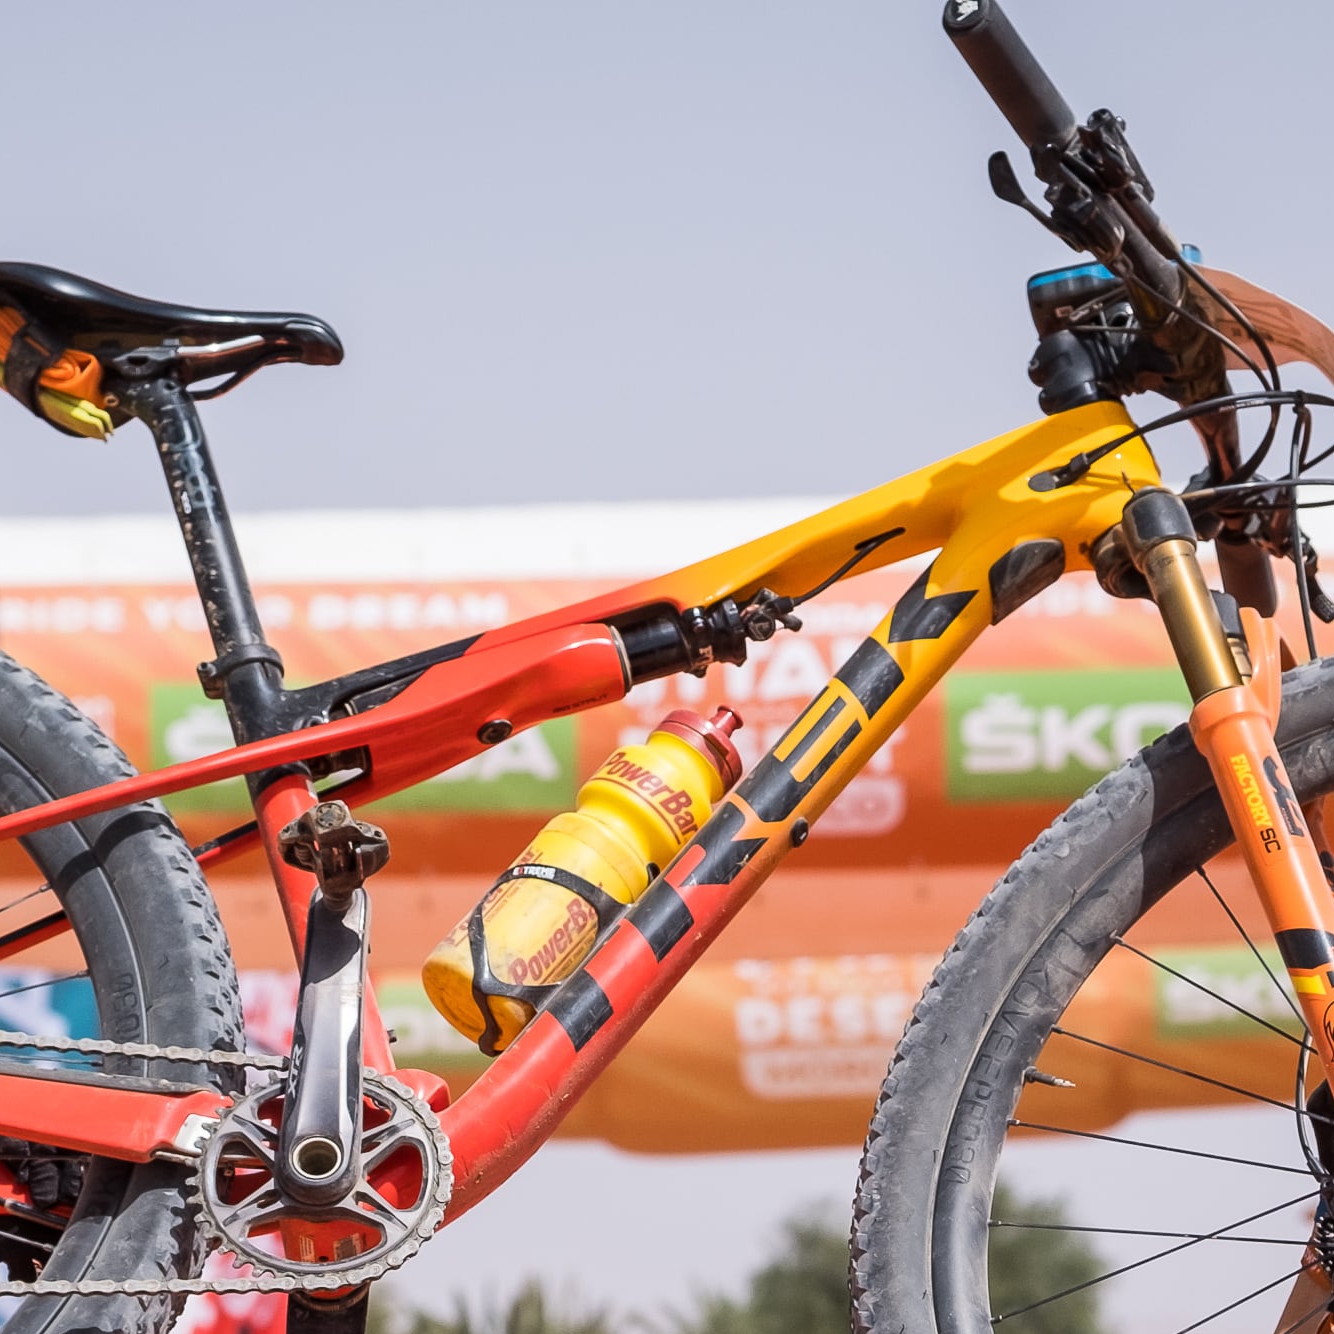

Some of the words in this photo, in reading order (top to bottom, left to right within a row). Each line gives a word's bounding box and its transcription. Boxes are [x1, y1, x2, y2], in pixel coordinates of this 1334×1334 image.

[143, 593, 295, 633] YOR
[308, 591, 508, 629] DREAM
[545, 547, 979, 1054] TREK
[605, 749, 699, 840] PowerBar
[1230, 753, 1271, 829] FACTORY
[1261, 827, 1281, 854] SC
[287, 1043, 305, 1099] XTR
